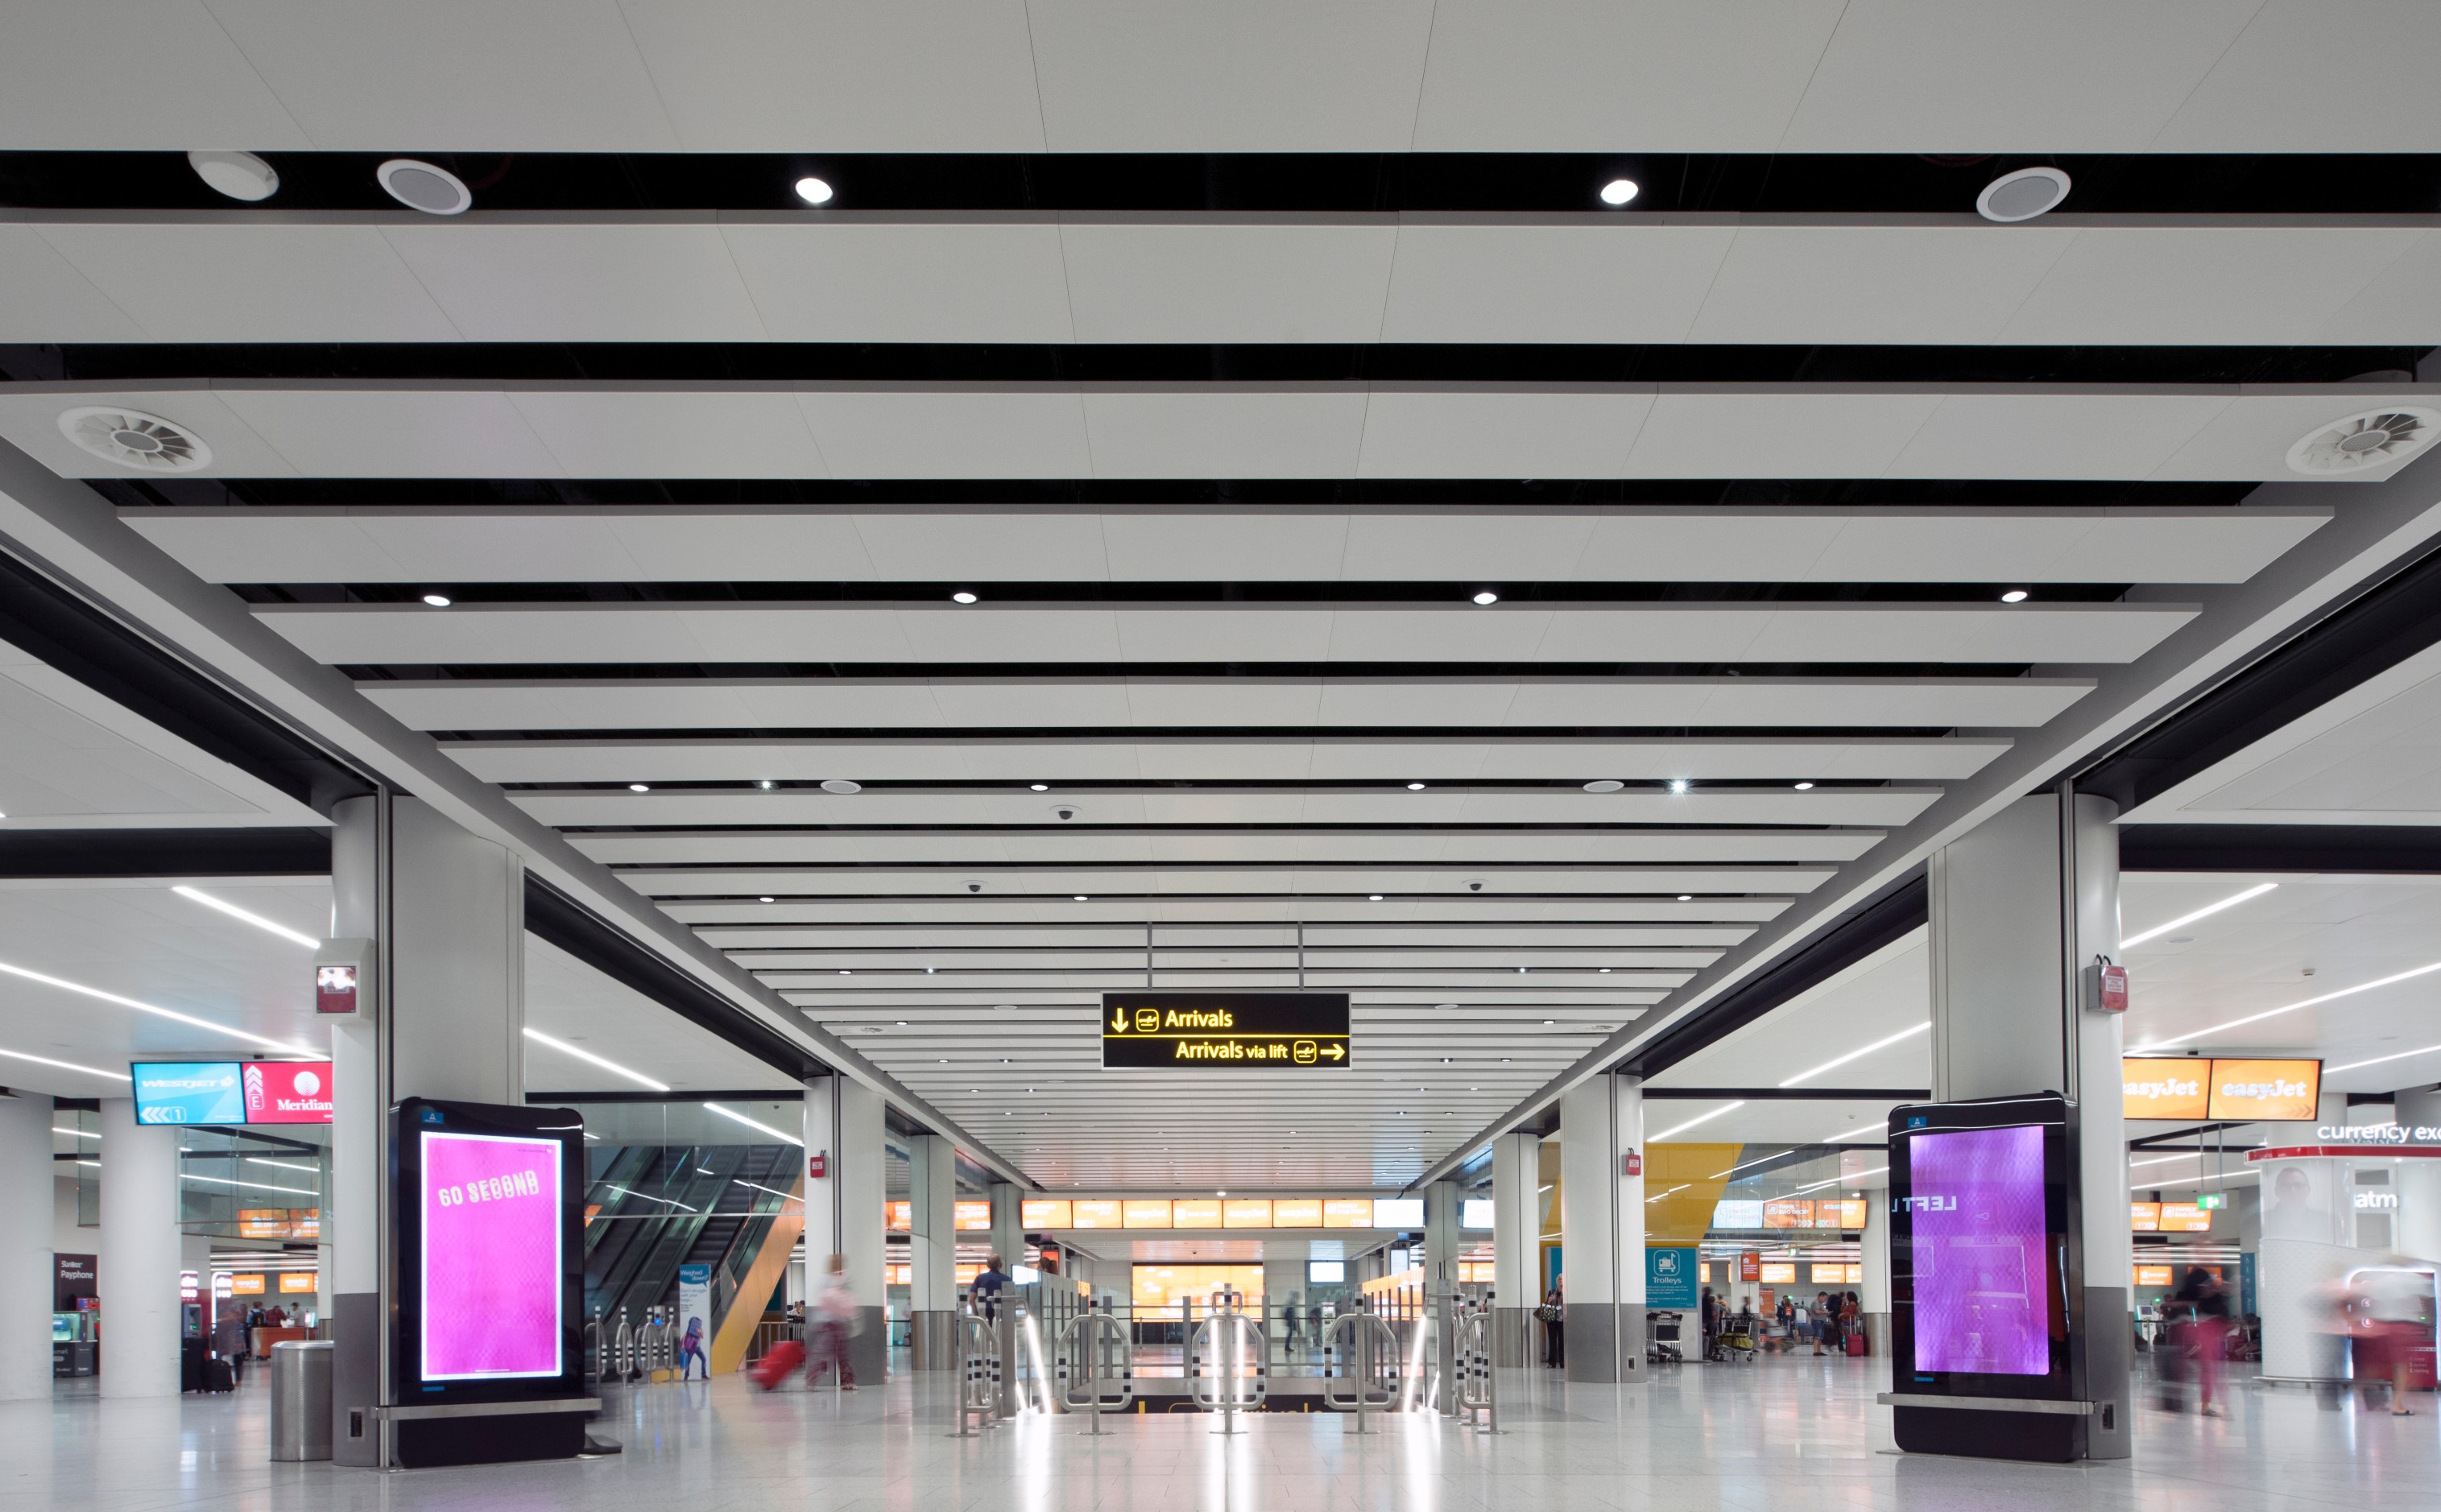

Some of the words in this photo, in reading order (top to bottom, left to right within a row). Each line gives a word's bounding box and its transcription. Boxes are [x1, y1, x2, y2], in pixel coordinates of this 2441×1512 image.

[1165, 1009, 1233, 1027] Arrivals
[1176, 1041, 1243, 1059] Arrivals
[1246, 1045, 1266, 1059] via
[1269, 1044, 1288, 1059] lift
[2222, 1079, 2307, 1100] easyJet
[251, 1096, 260, 1108] E
[277, 1099, 333, 1110] Meridian
[175, 1109, 181, 1121] 1
[2317, 1126, 2411, 1143] currency
[438, 1186, 463, 1207] 60
[466, 1170, 539, 1203] SECOND
[2355, 1191, 2398, 1208] atm
[61, 1270, 93, 1279] Payphone
[1653, 1277, 1682, 1285] Trolleys
